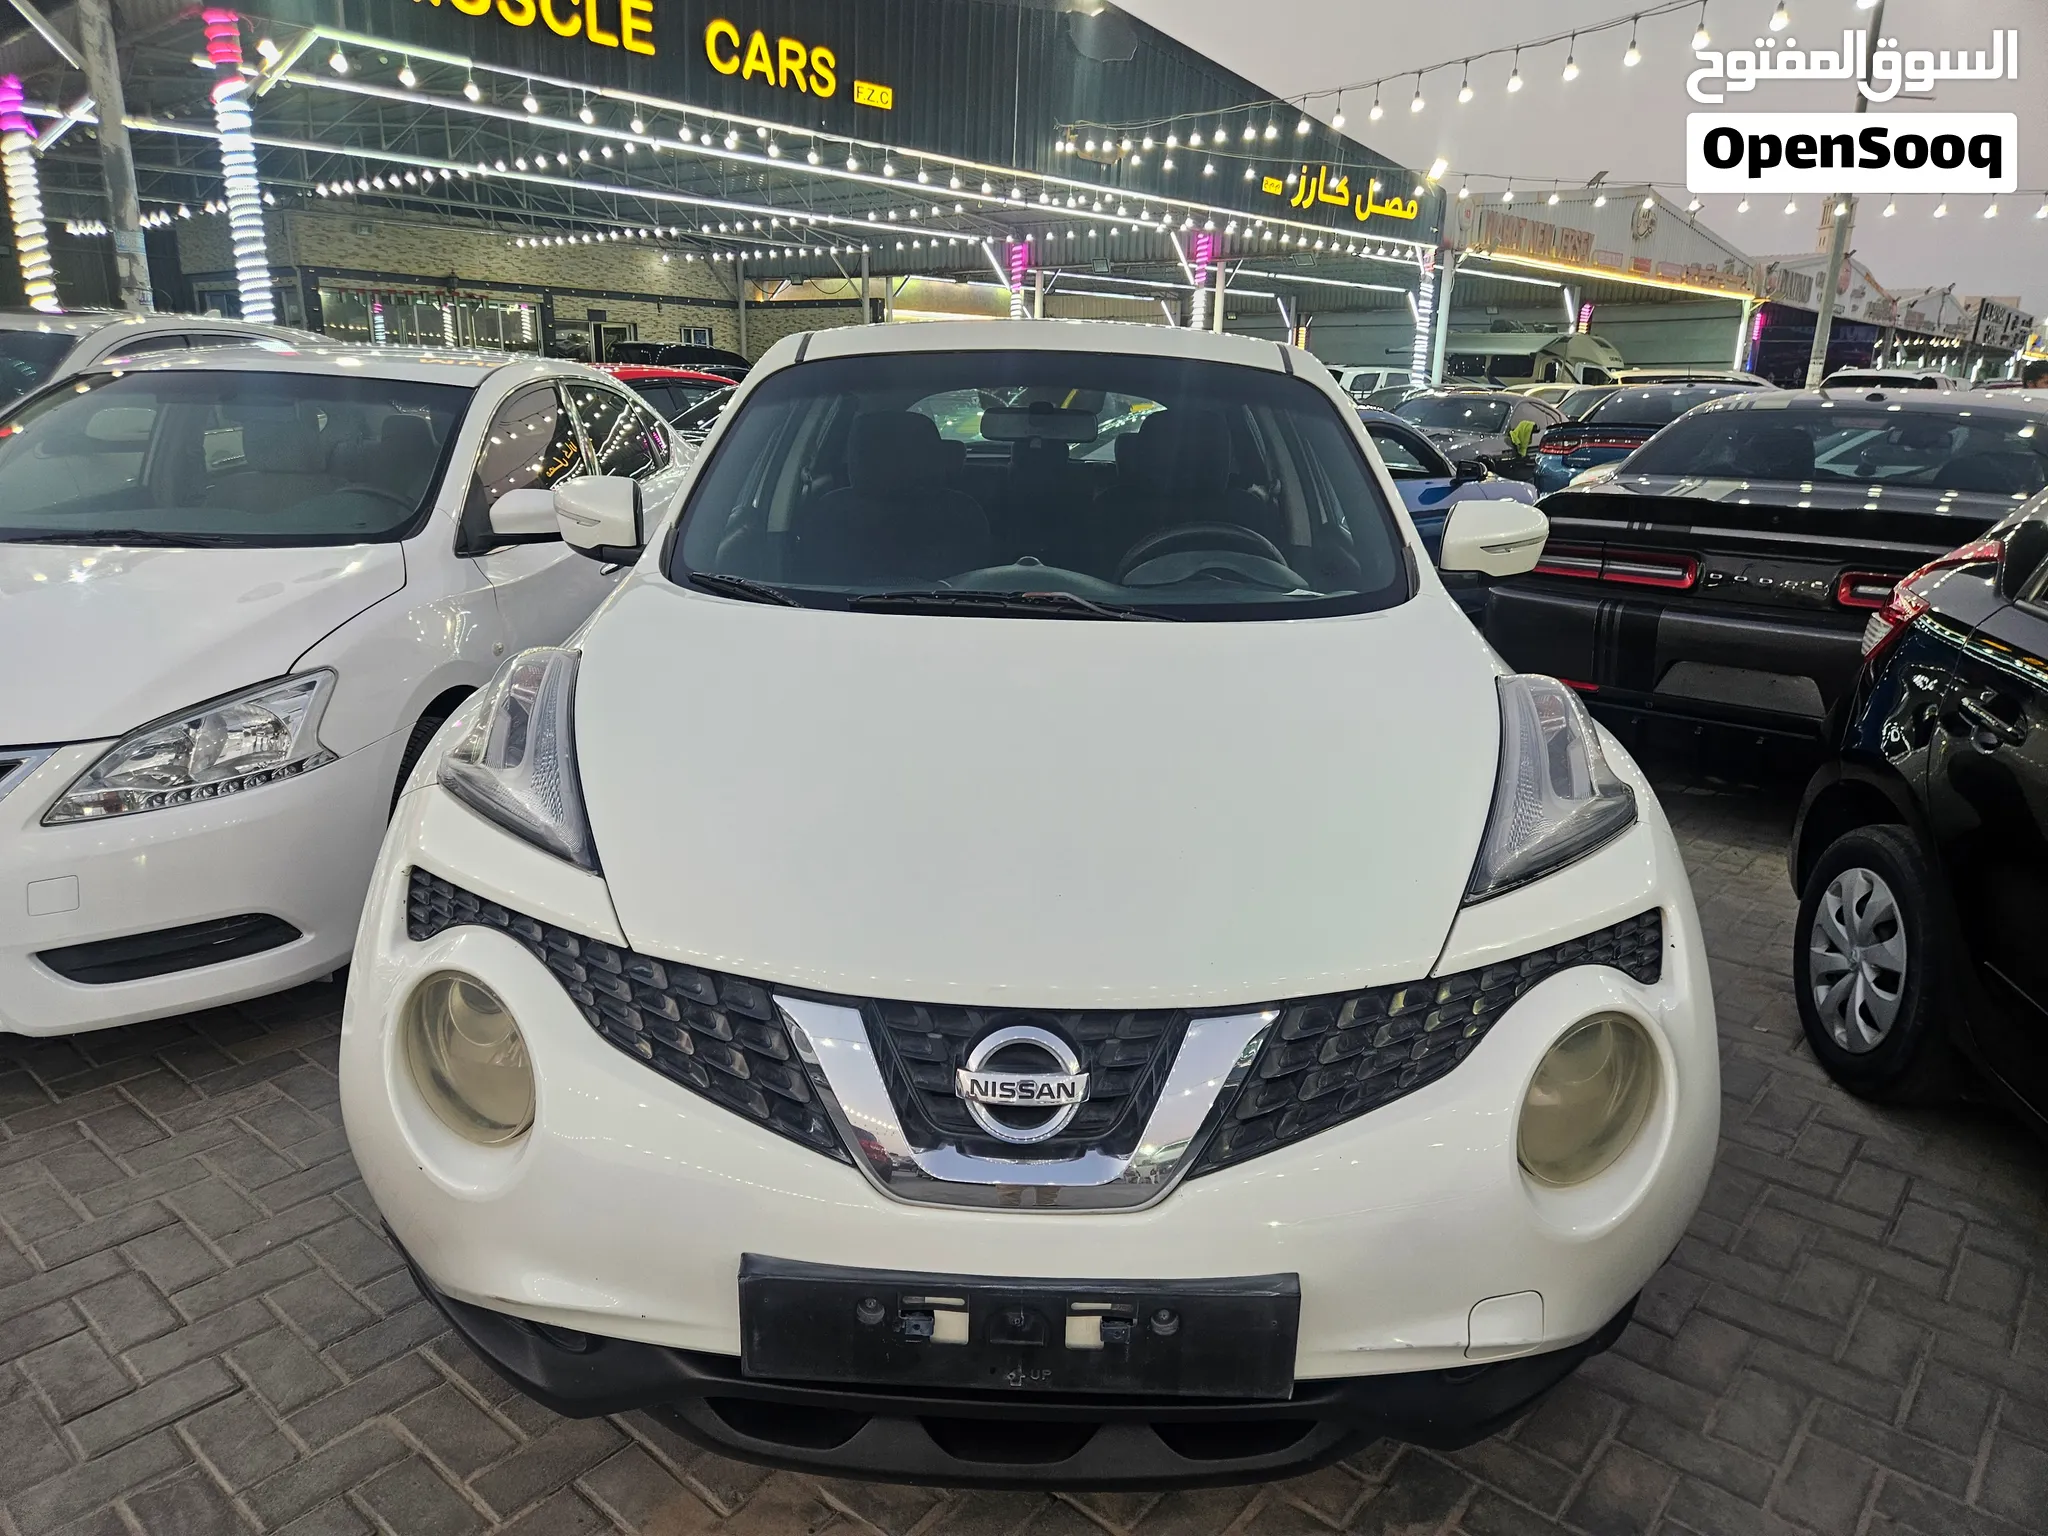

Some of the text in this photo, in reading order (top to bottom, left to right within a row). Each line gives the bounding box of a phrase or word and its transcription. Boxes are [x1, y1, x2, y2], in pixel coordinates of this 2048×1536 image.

[705, 18, 837, 98] CARS
[1290, 164, 1350, 209] كارز
[1354, 178, 1418, 222] مصل
[970, 1078, 1076, 1100] NISSAN
[1030, 1368, 1052, 1381] UP
